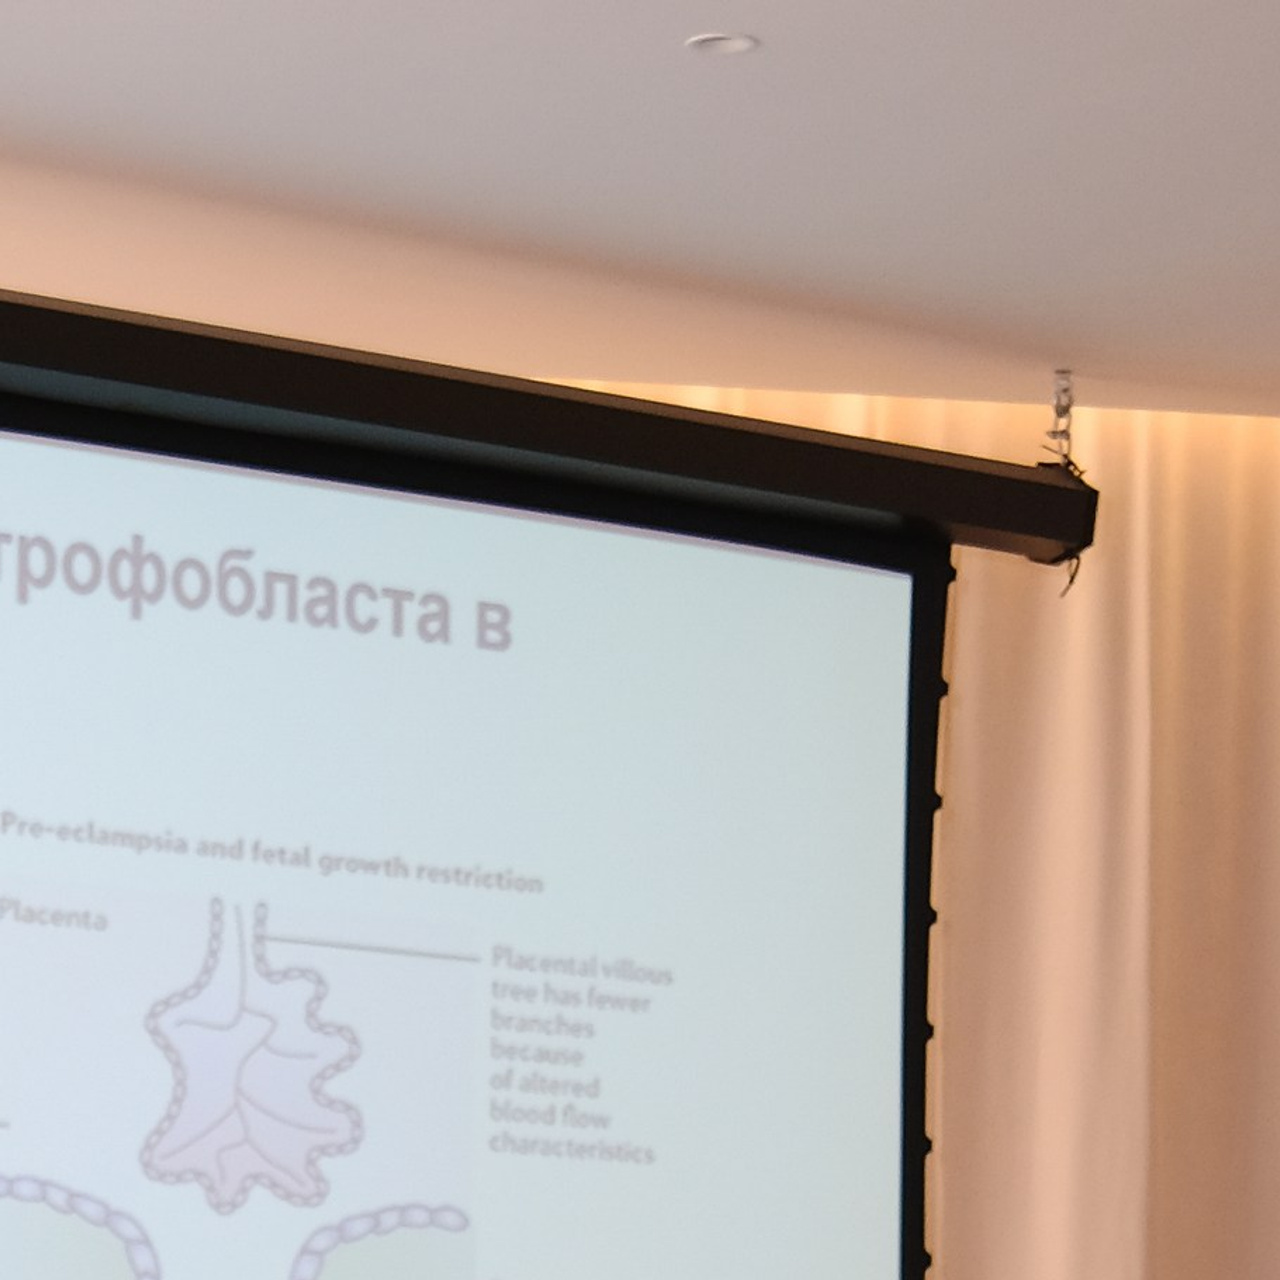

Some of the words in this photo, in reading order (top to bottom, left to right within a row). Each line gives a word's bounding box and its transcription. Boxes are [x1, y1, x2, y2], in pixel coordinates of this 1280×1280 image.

[476, 601, 514, 653] в
[0, 810, 189, 855] Pre-eclampsia
[196, 837, 244, 862] and
[251, 840, 311, 869] fetal
[318, 851, 410, 881] growth
[416, 861, 545, 894] restriction
[489, 1068, 514, 1090] of
